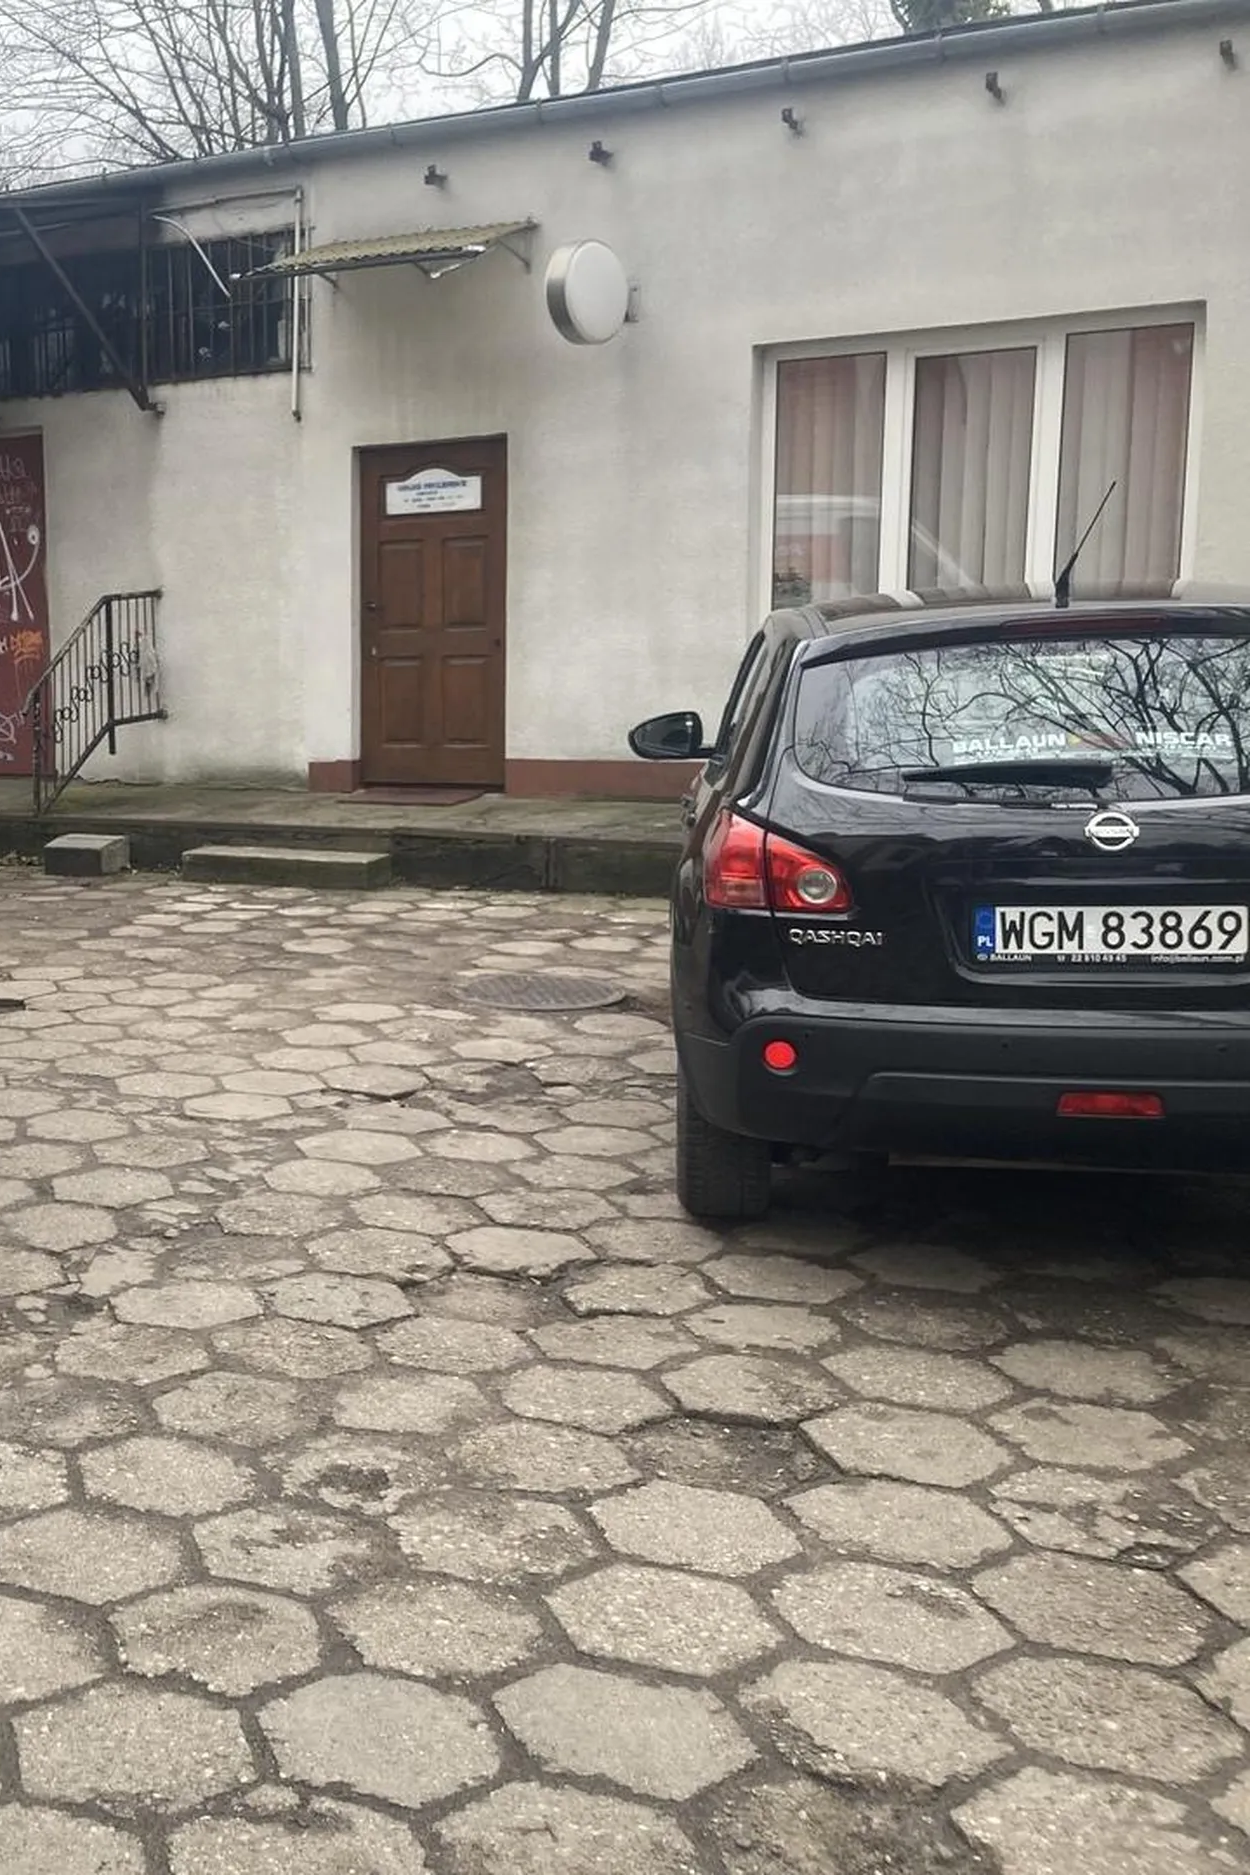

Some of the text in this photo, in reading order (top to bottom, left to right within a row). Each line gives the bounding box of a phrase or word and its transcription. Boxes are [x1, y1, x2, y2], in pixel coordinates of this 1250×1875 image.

[952, 731, 1234, 753] BALLAUN NISCAR
[790, 928, 882, 947] QASHQAI
[1000, 910, 1243, 950] WGM 83869
[977, 935, 993, 947] PL
